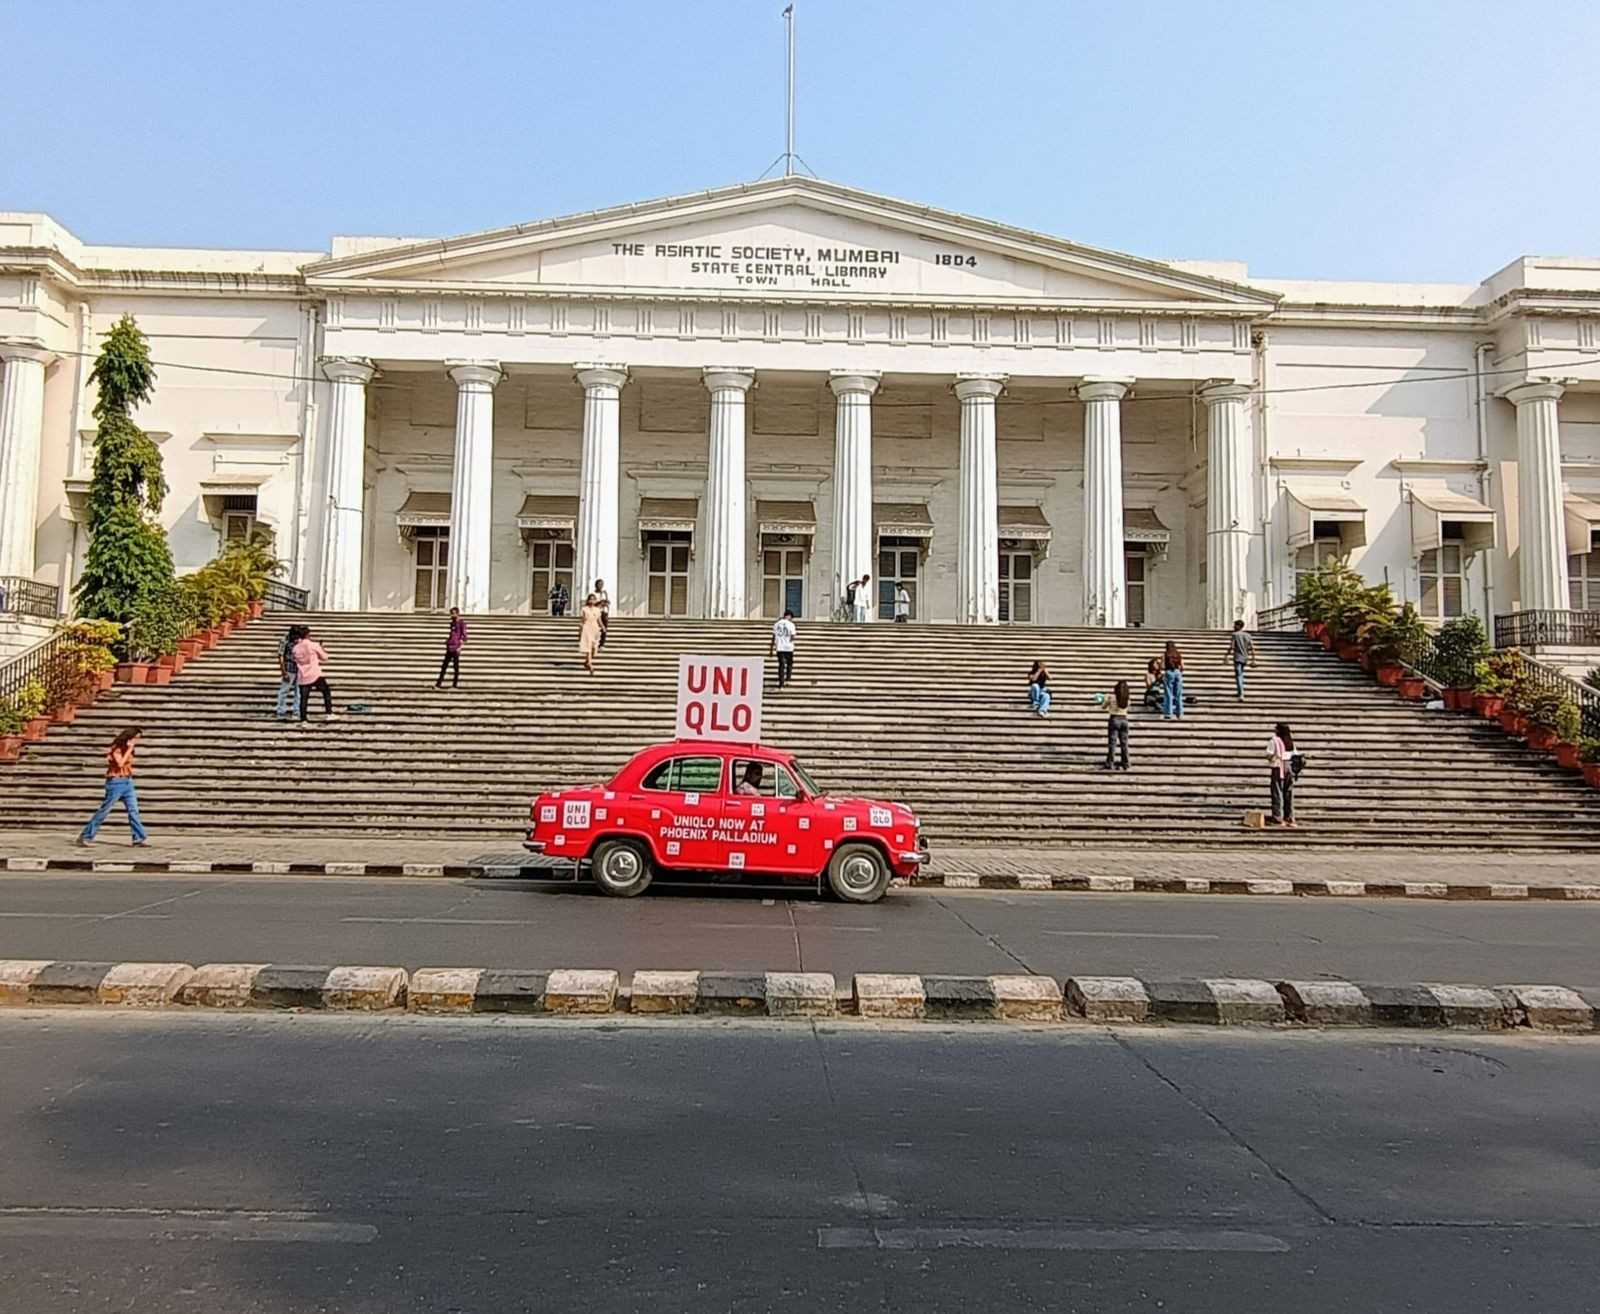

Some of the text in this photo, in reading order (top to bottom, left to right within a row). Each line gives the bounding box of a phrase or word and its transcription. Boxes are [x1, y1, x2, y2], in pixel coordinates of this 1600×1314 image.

[612, 243, 977, 268] THE ASIATIC SOCIETY, MUMBAI 1804
[691, 262, 887, 278] STATE CENTRAL LIBRARY
[736, 275, 851, 287] TOWN HALL
[687, 665, 748, 696] UNI
[685, 701, 752, 735] QLO
[567, 804, 586, 814] UNI
[566, 815, 587, 825] QLO
[673, 816, 766, 831] UNIQLO NOW AT
[873, 815, 890, 824] QLO
[660, 827, 778, 844] PHOENIX PALLADIUM
